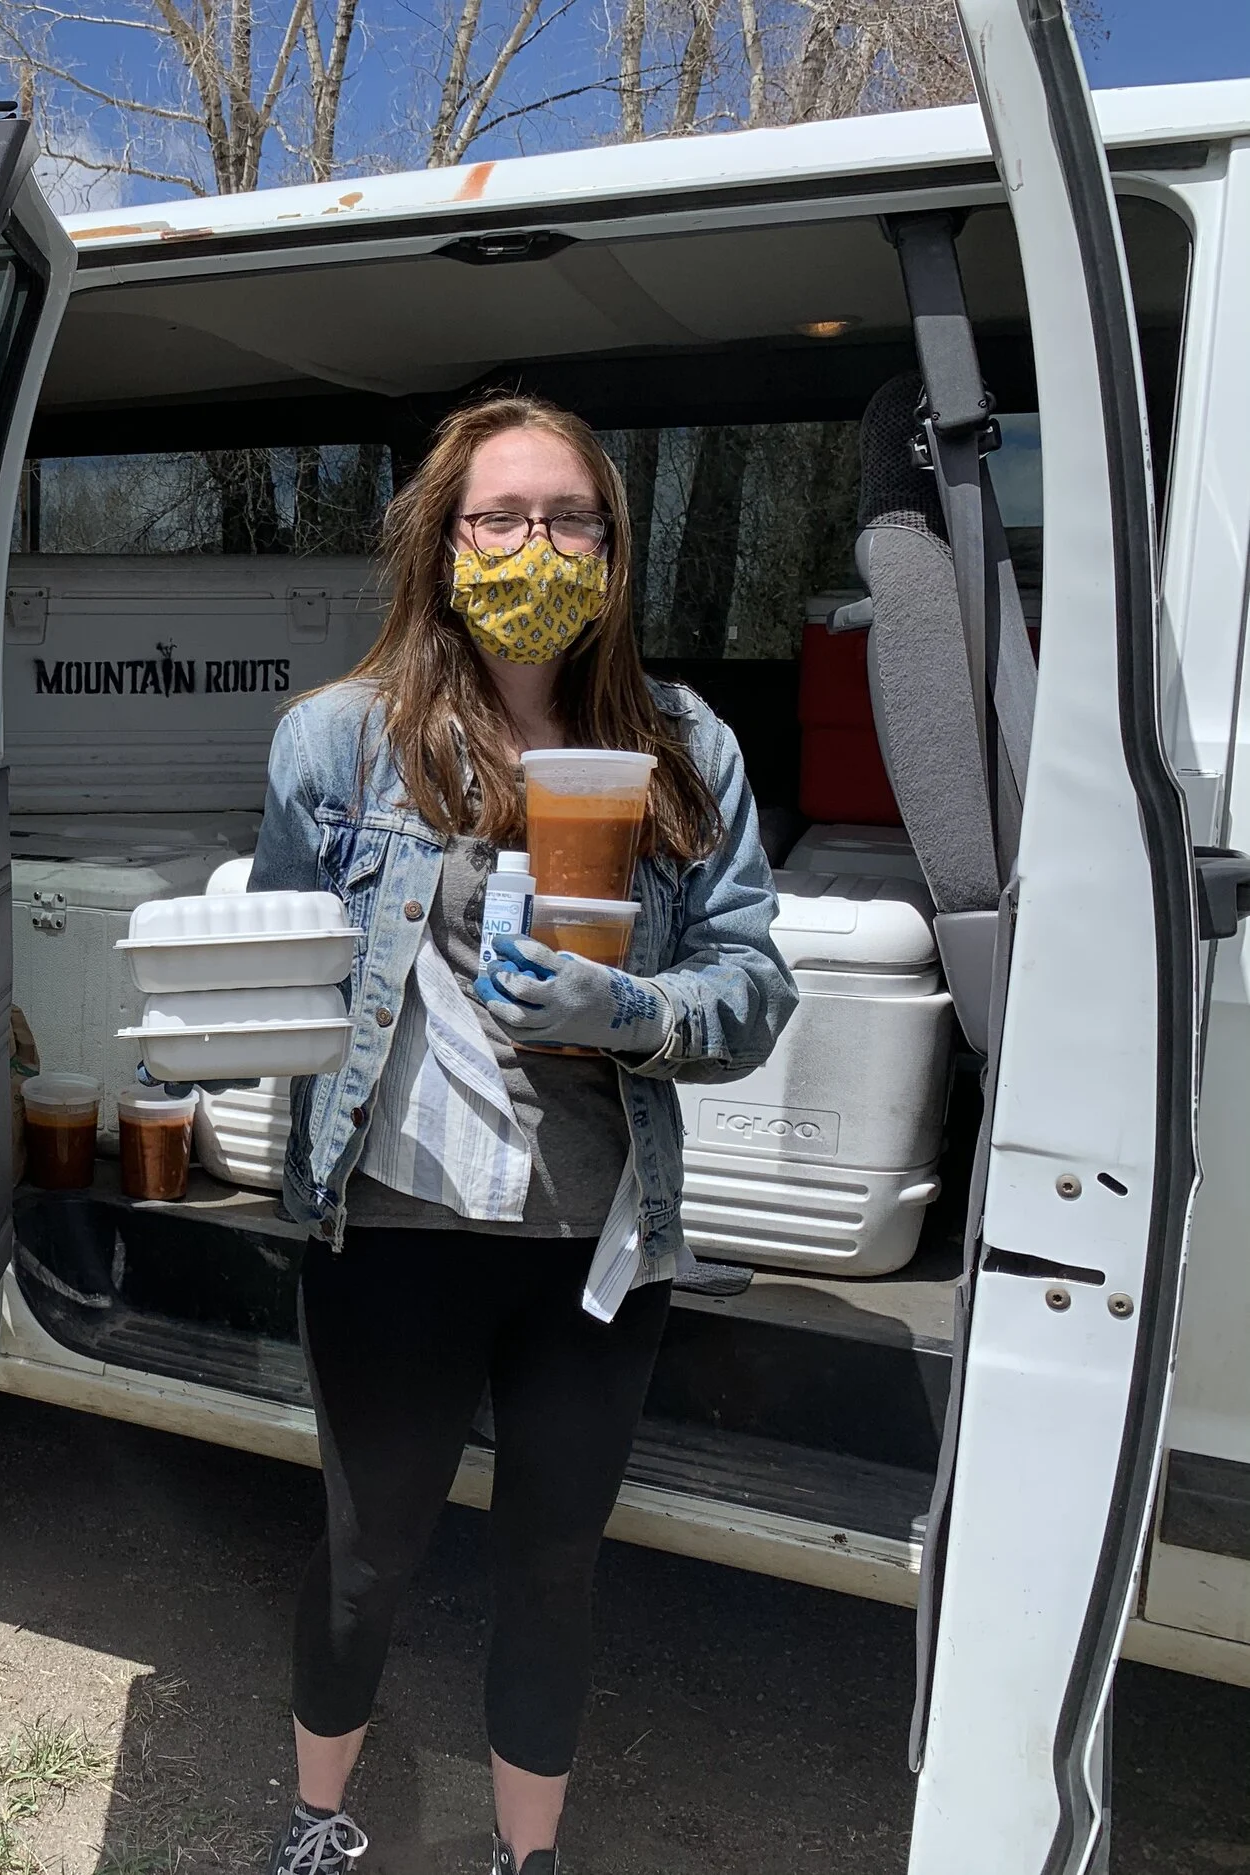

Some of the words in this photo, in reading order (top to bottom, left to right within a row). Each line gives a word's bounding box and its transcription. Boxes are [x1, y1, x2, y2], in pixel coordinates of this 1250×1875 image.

[34, 659, 195, 697] MOUNTAIN
[204, 659, 290, 694] ROOTS
[484, 920, 512, 932] AND
